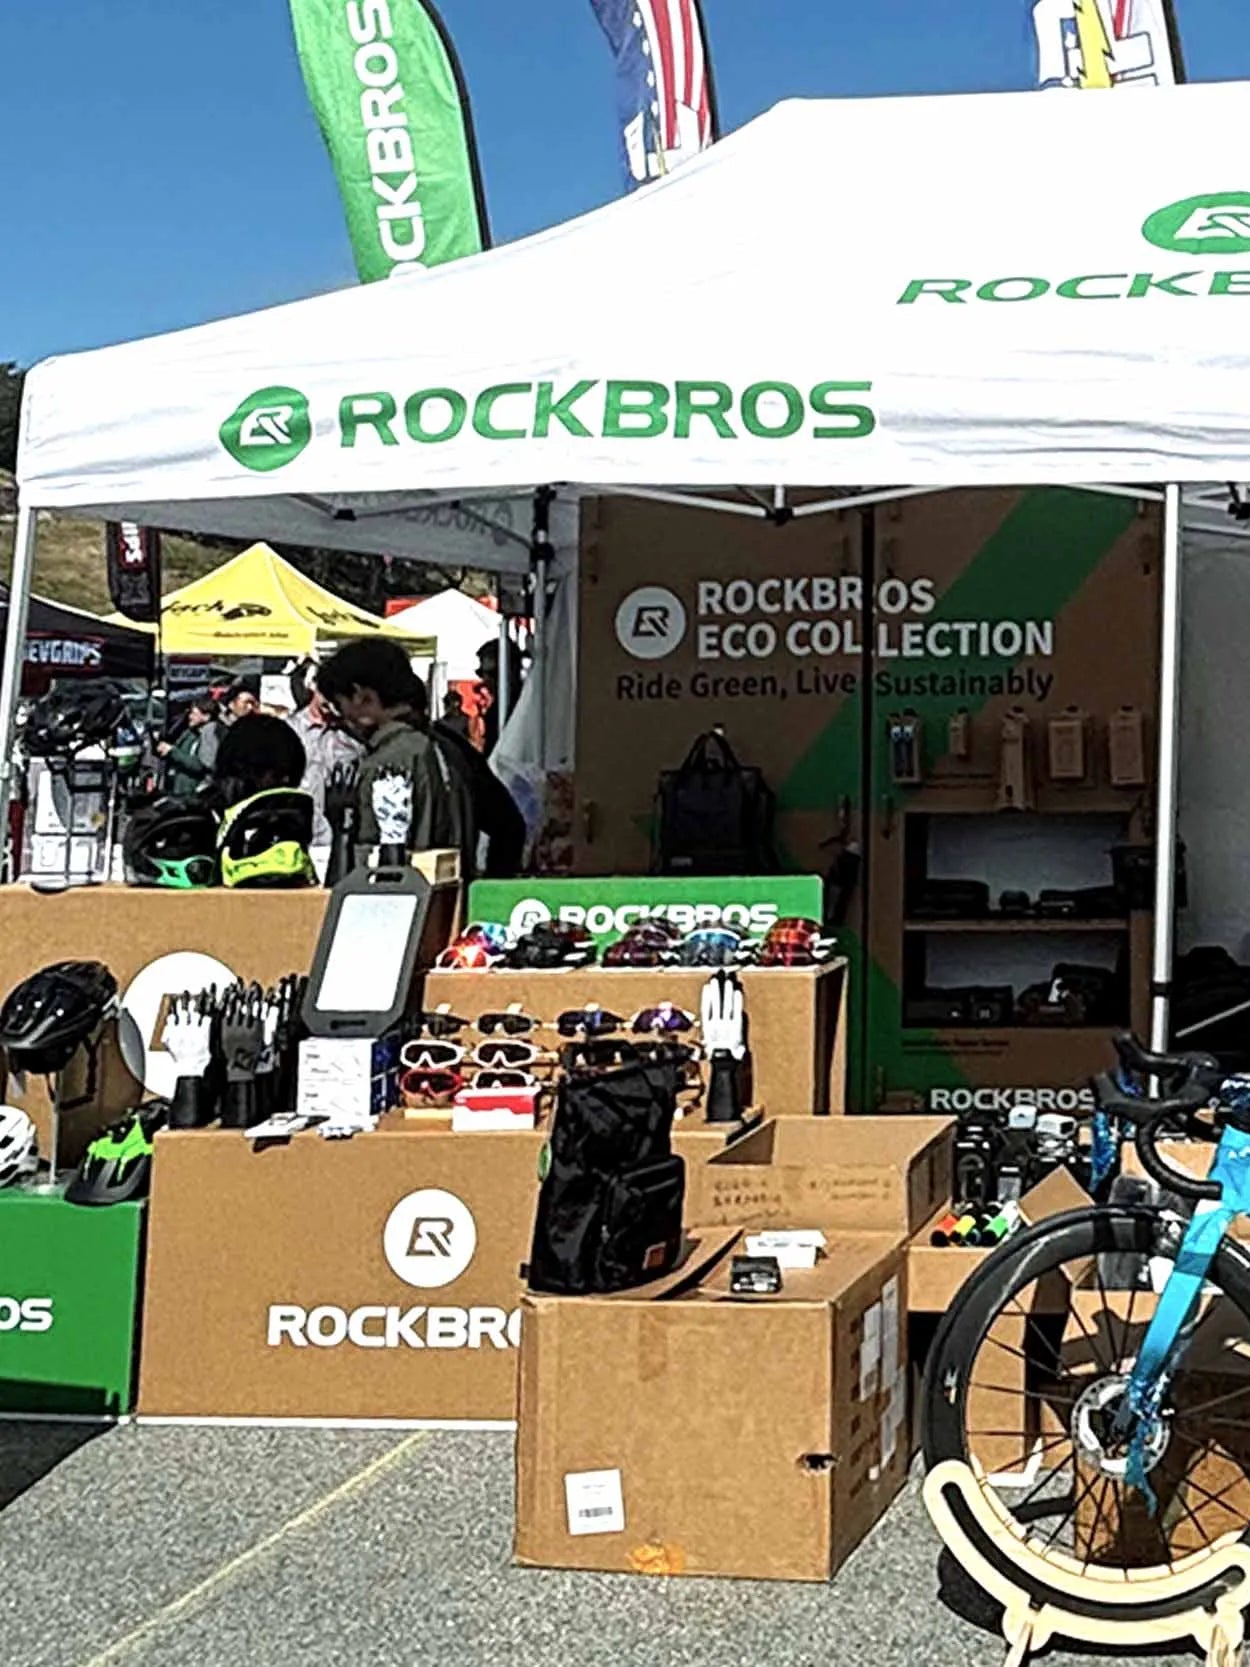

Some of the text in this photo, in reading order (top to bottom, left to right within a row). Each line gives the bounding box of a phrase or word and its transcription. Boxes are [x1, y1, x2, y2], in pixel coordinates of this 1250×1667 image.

[340, 379, 876, 448] ROCKBROS
[698, 576, 936, 616] ROCKBROS
[699, 620, 1054, 659] ECO COLLECTION
[616, 664, 1055, 701] Ride Green, Live Sustainably
[930, 1088, 1095, 1111] ROCKBROS
